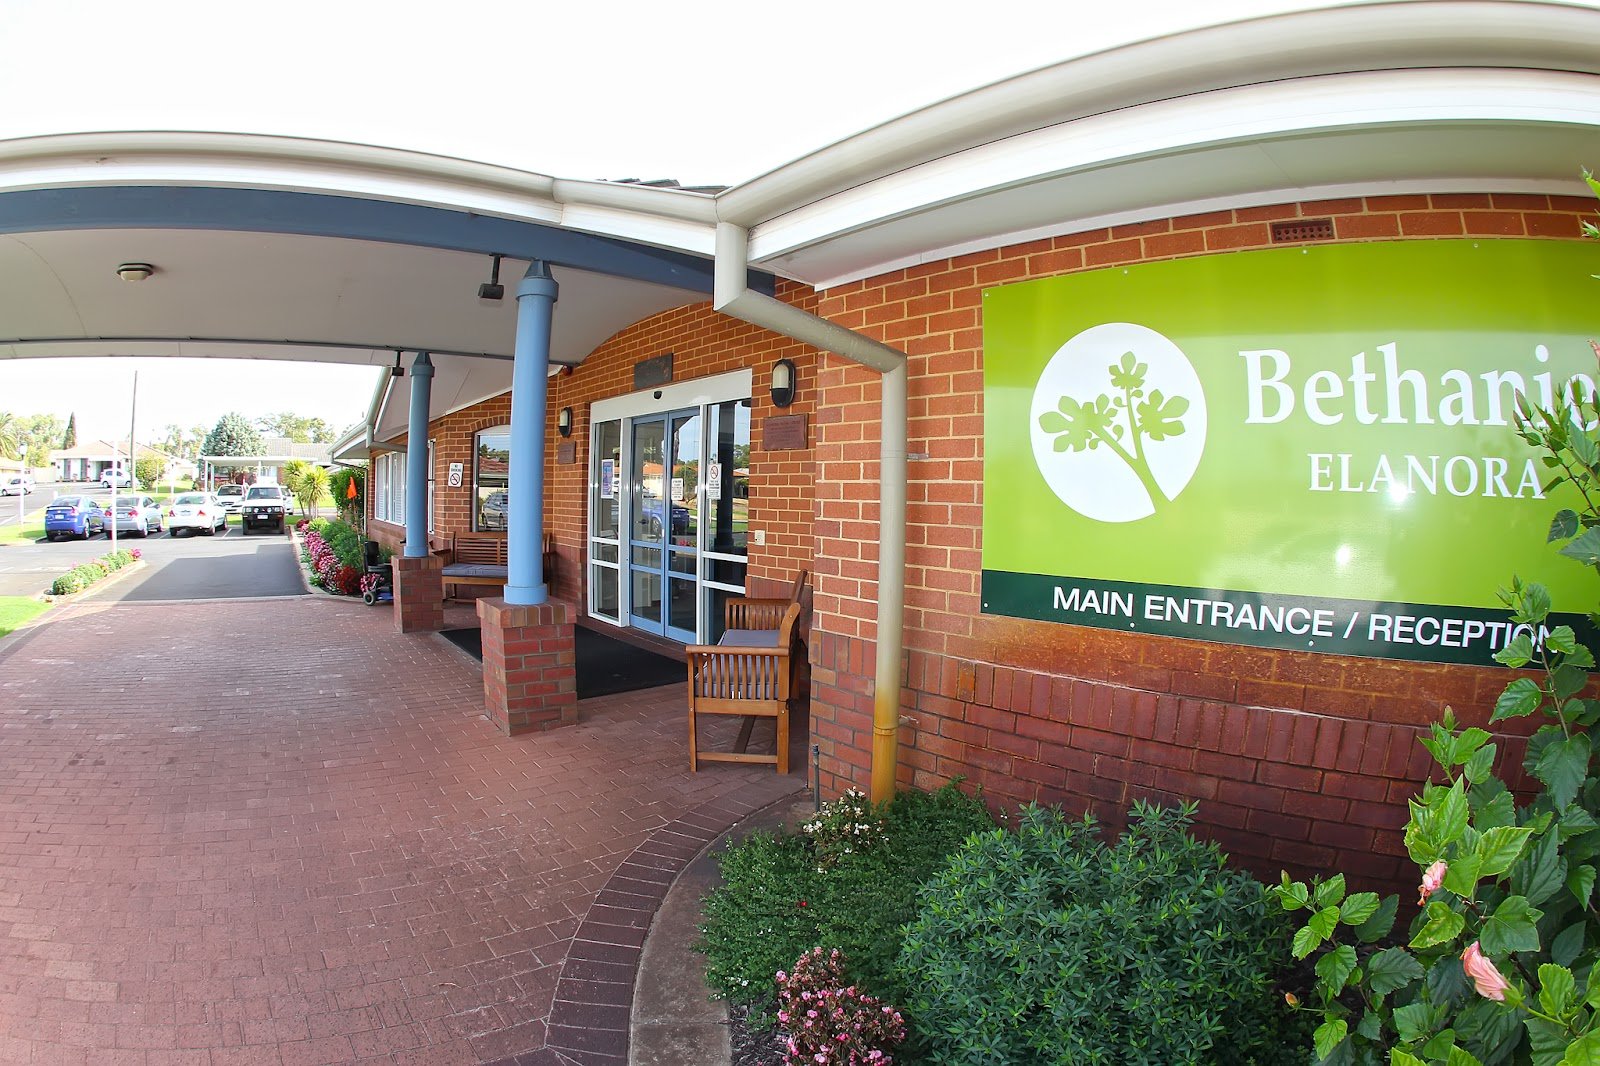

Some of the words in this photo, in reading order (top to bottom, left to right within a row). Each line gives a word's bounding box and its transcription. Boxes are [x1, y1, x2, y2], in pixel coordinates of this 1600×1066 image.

[1238, 341, 1600, 432] Bethanie
[1307, 453, 1546, 499] ELANORA
[1053, 586, 1134, 617] MAIN
[1144, 594, 1335, 637] ENTRANCE
[1342, 612, 1359, 639] /
